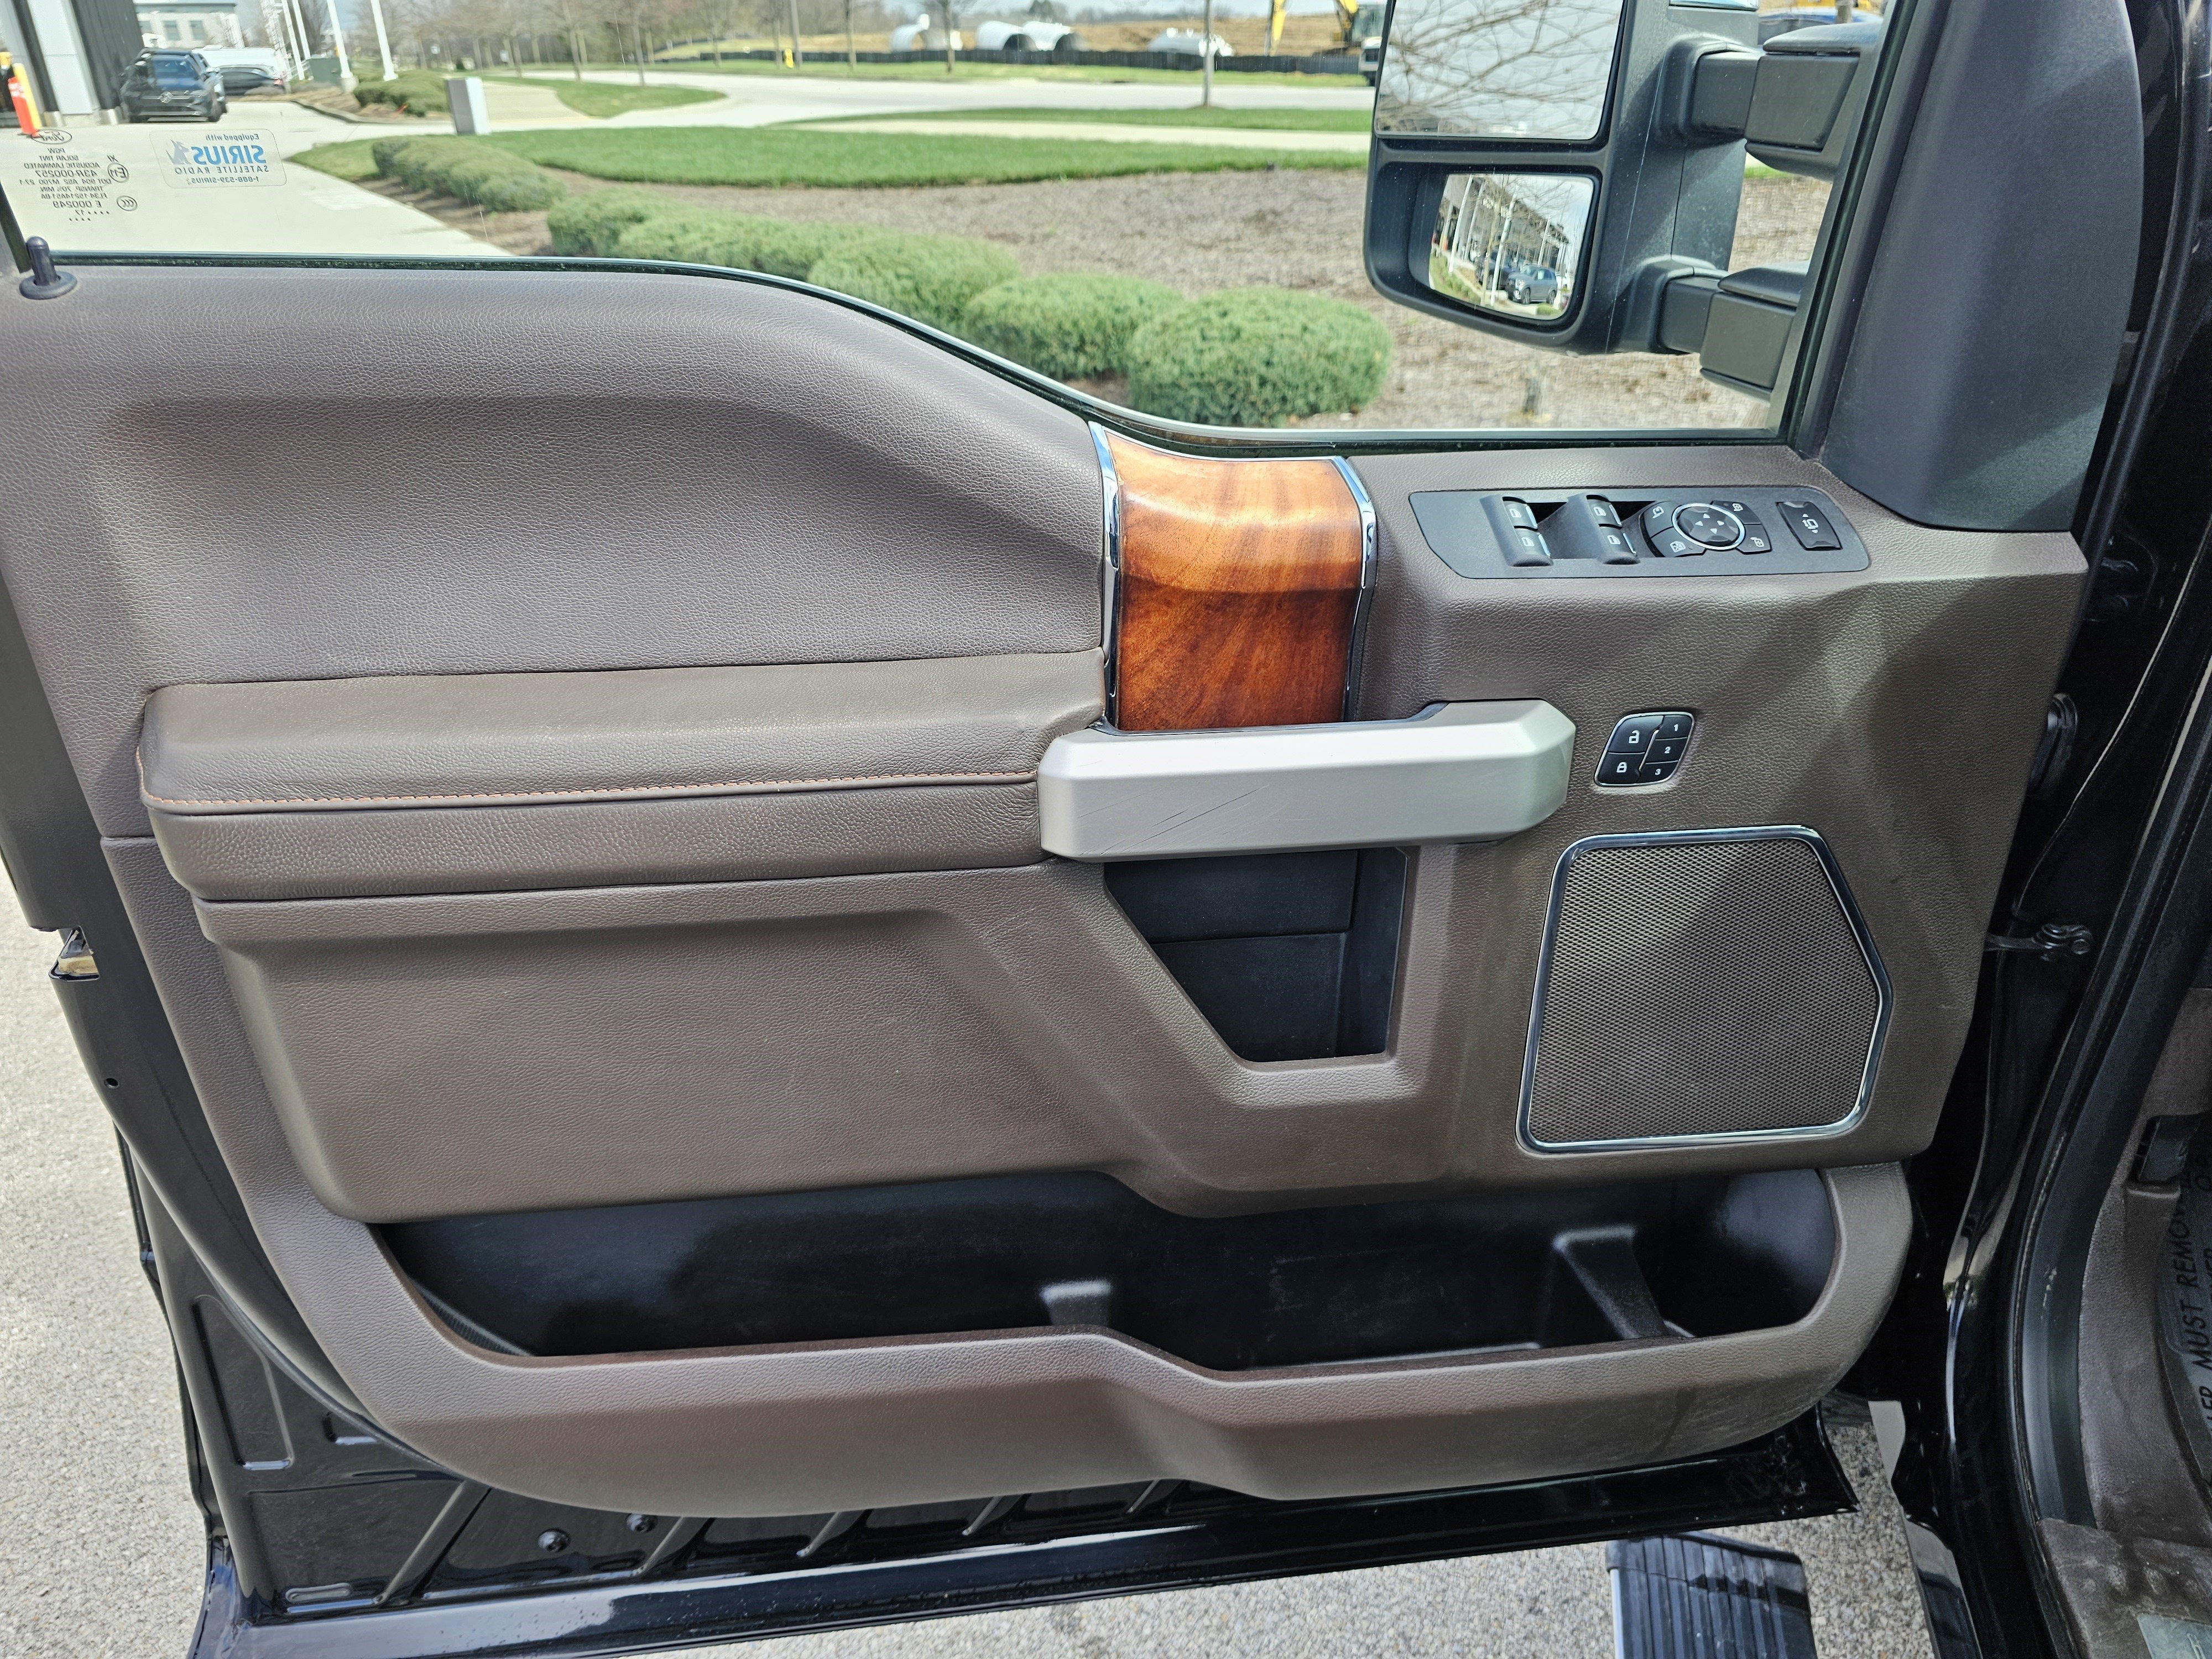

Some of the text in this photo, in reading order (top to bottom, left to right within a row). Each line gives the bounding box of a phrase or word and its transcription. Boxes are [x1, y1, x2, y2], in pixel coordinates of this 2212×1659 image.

[1673, 723, 1679, 732] 1
[1664, 746, 1672, 754] 2
[2179, 1300, 2212, 1371] MUST
